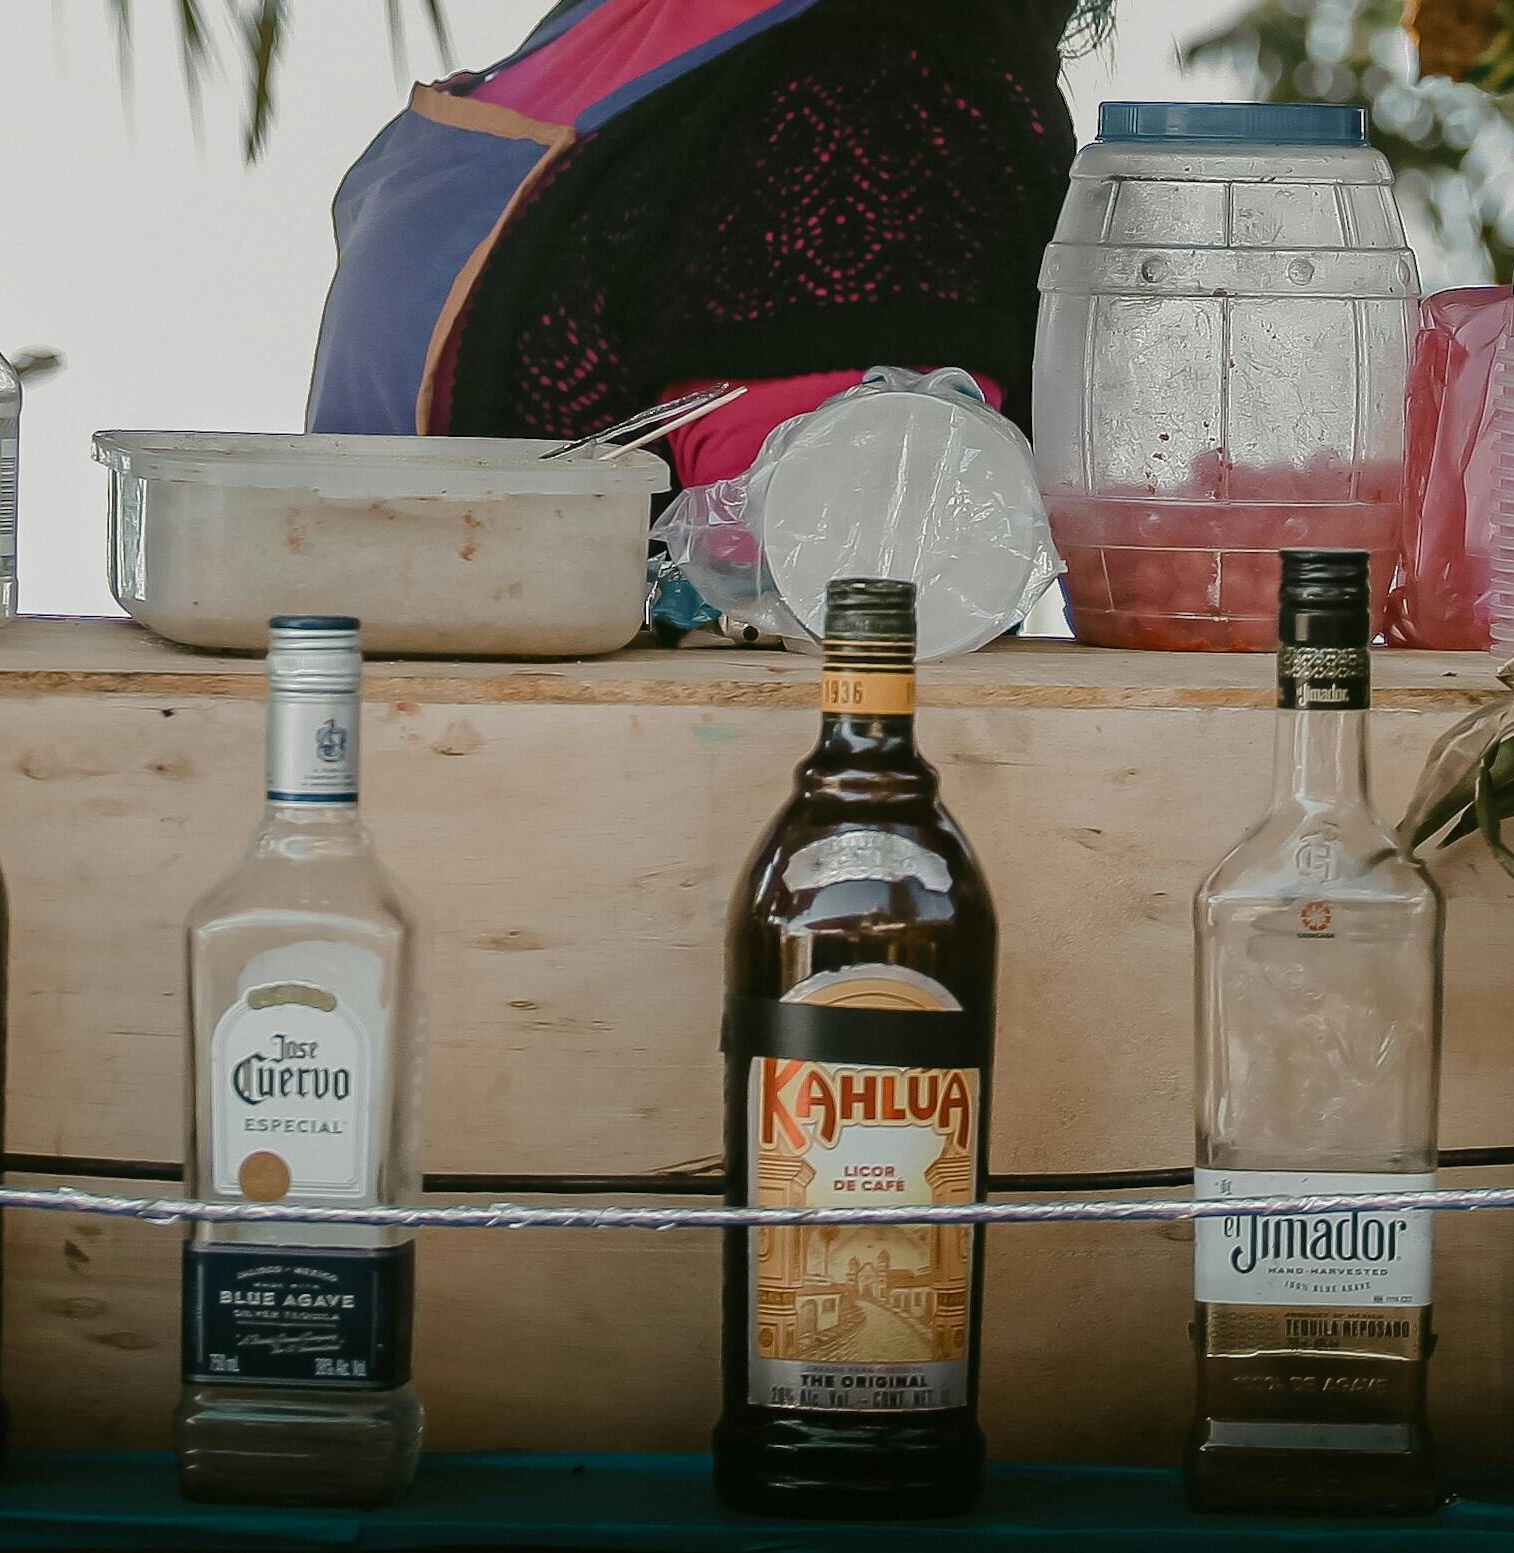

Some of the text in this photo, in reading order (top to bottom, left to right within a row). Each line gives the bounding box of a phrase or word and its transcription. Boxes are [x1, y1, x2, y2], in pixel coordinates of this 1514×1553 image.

[271, 1034, 319, 1063] Jose
[233, 1053, 350, 1106] Cuervo
[245, 1116, 343, 1134] ESPECIAL
[844, 1165, 895, 1178] LICOR
[833, 1180, 856, 1192] DE
[1231, 1210, 1407, 1274] Jimador
[1268, 1266, 1389, 1277] HAND-HARVESTED
[1313, 1283, 1338, 1294] BLUE
[1341, 1281, 1372, 1293] AGAVE
[219, 1289, 355, 1309] BLUE AGAVE
[1286, 1319, 1411, 1338] TEQUILA REPOSADO
[801, 1373, 928, 1389] THE ORIGINAL
